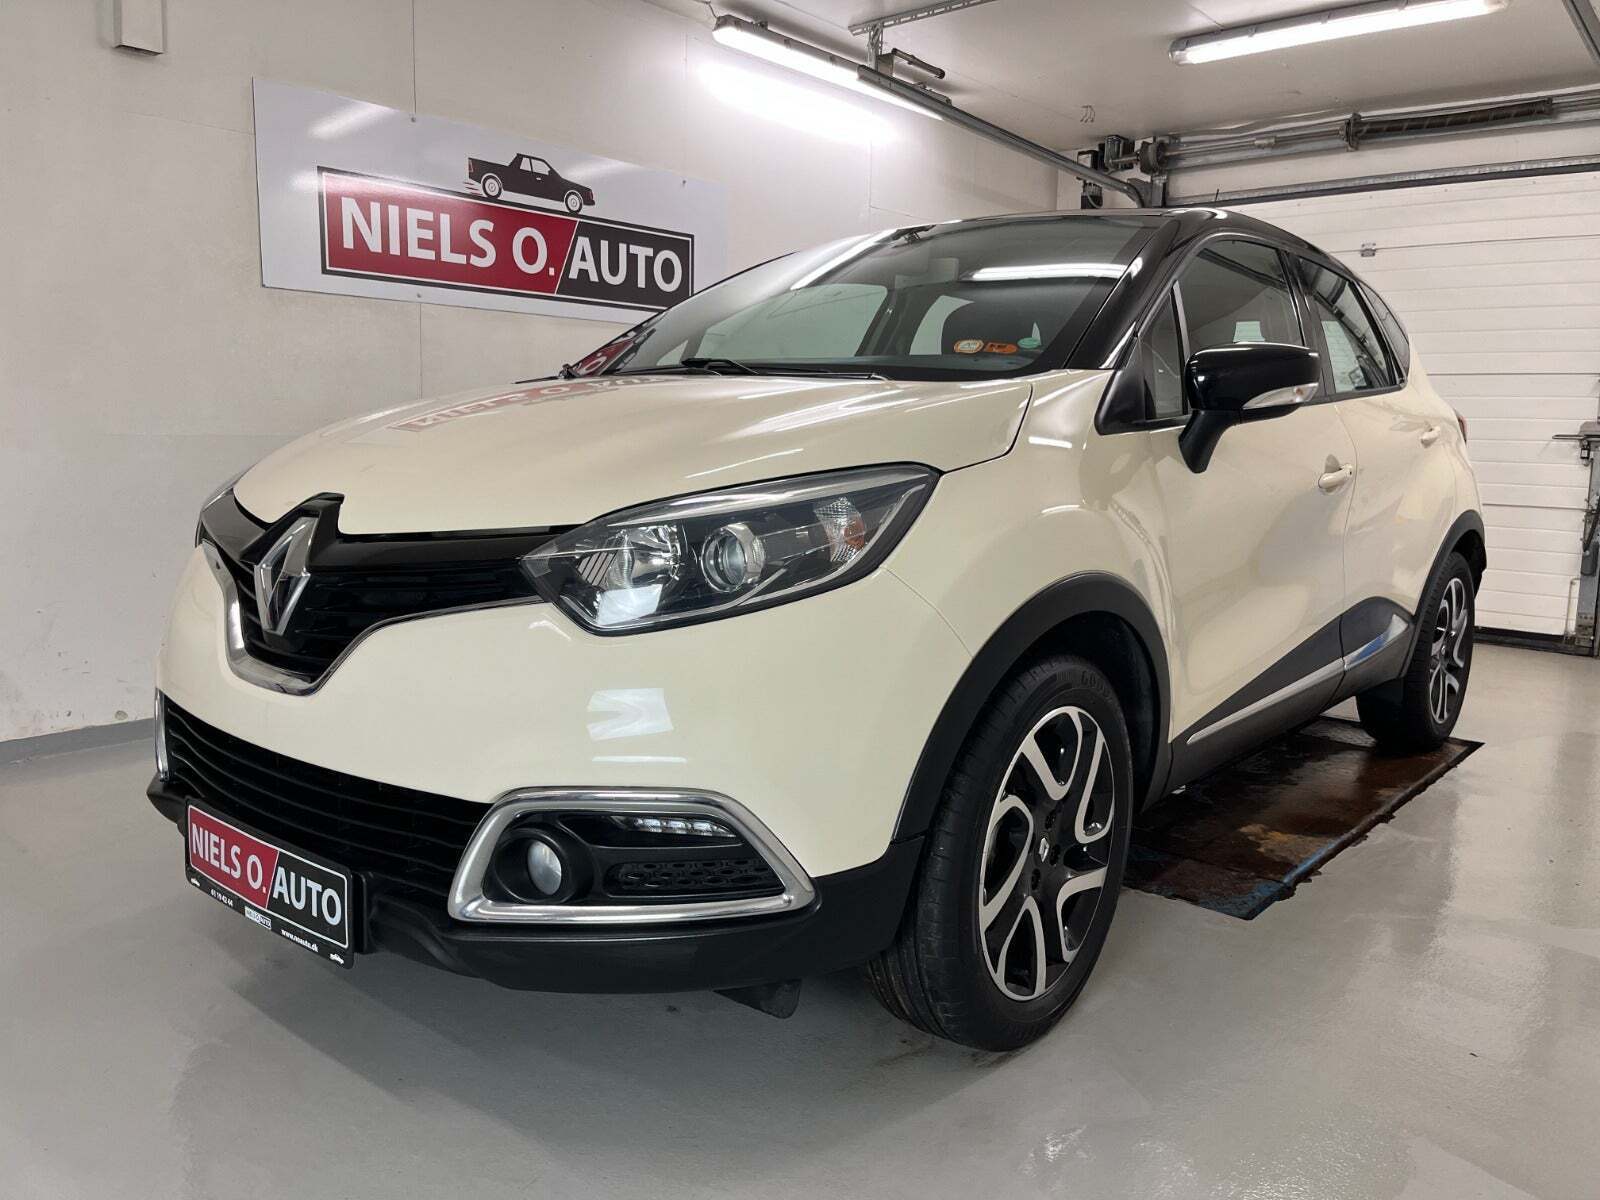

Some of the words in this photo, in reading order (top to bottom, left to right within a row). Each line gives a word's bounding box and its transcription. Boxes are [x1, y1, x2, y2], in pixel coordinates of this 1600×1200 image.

[341, 197, 496, 268] NIELS
[512, 227, 555, 276] O.
[568, 236, 682, 292] AUTO
[191, 823, 241, 879] NIELS
[246, 854, 267, 894] O.
[272, 866, 342, 926] AUTO
